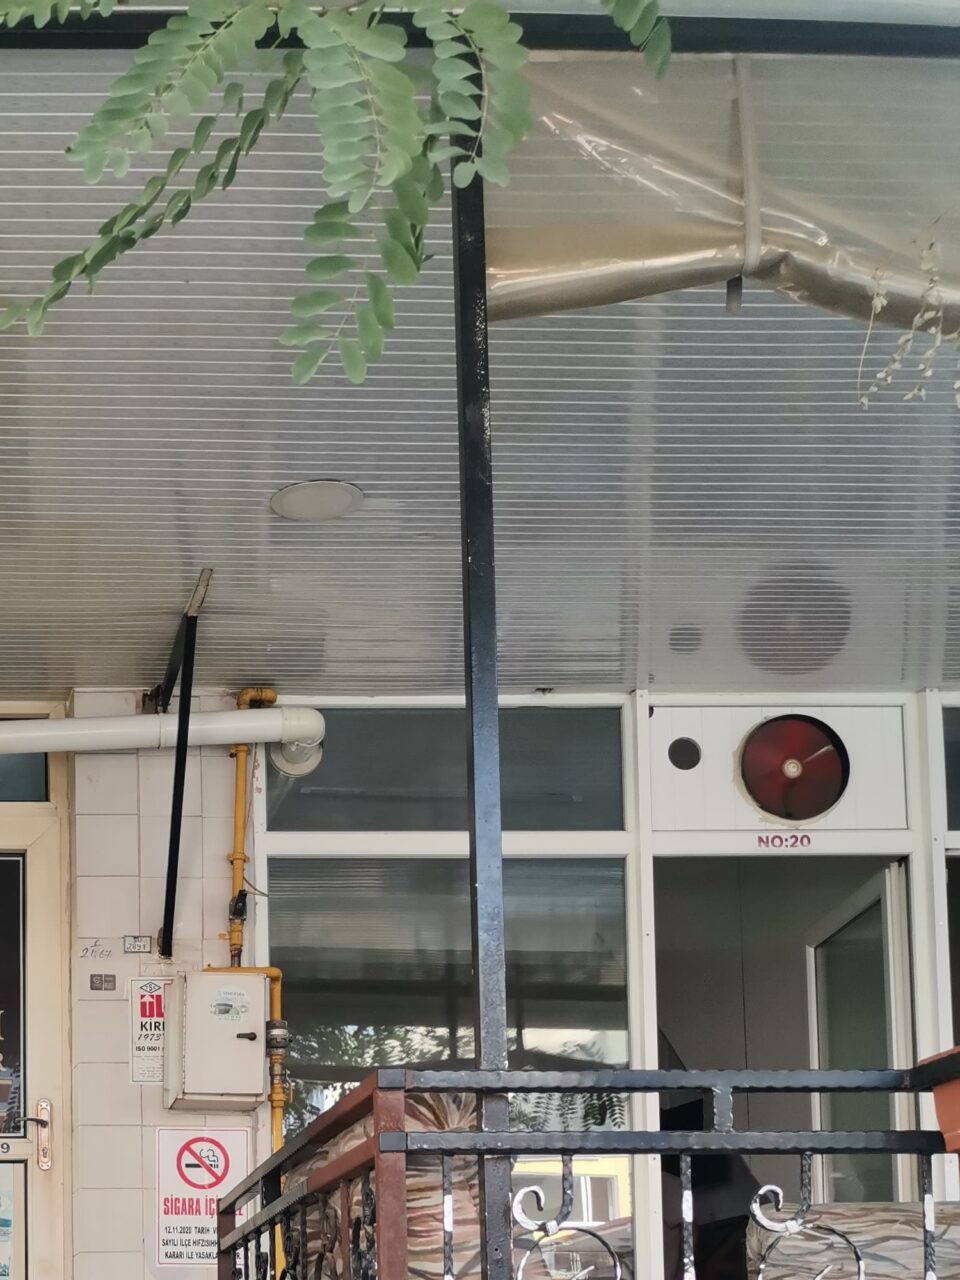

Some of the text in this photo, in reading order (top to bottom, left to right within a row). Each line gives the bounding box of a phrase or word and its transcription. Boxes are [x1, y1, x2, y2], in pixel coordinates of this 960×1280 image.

[757, 834, 811, 848] NO:20
[163, 1194, 202, 1216] SİGARA
[164, 1226, 192, 1235] 12.11.2020
[161, 1239, 178, 1247] SAYILI
[179, 1237, 191, 1248] İLÇE
[164, 1251, 185, 1259] KARARI
[186, 1250, 194, 1259] İLE
